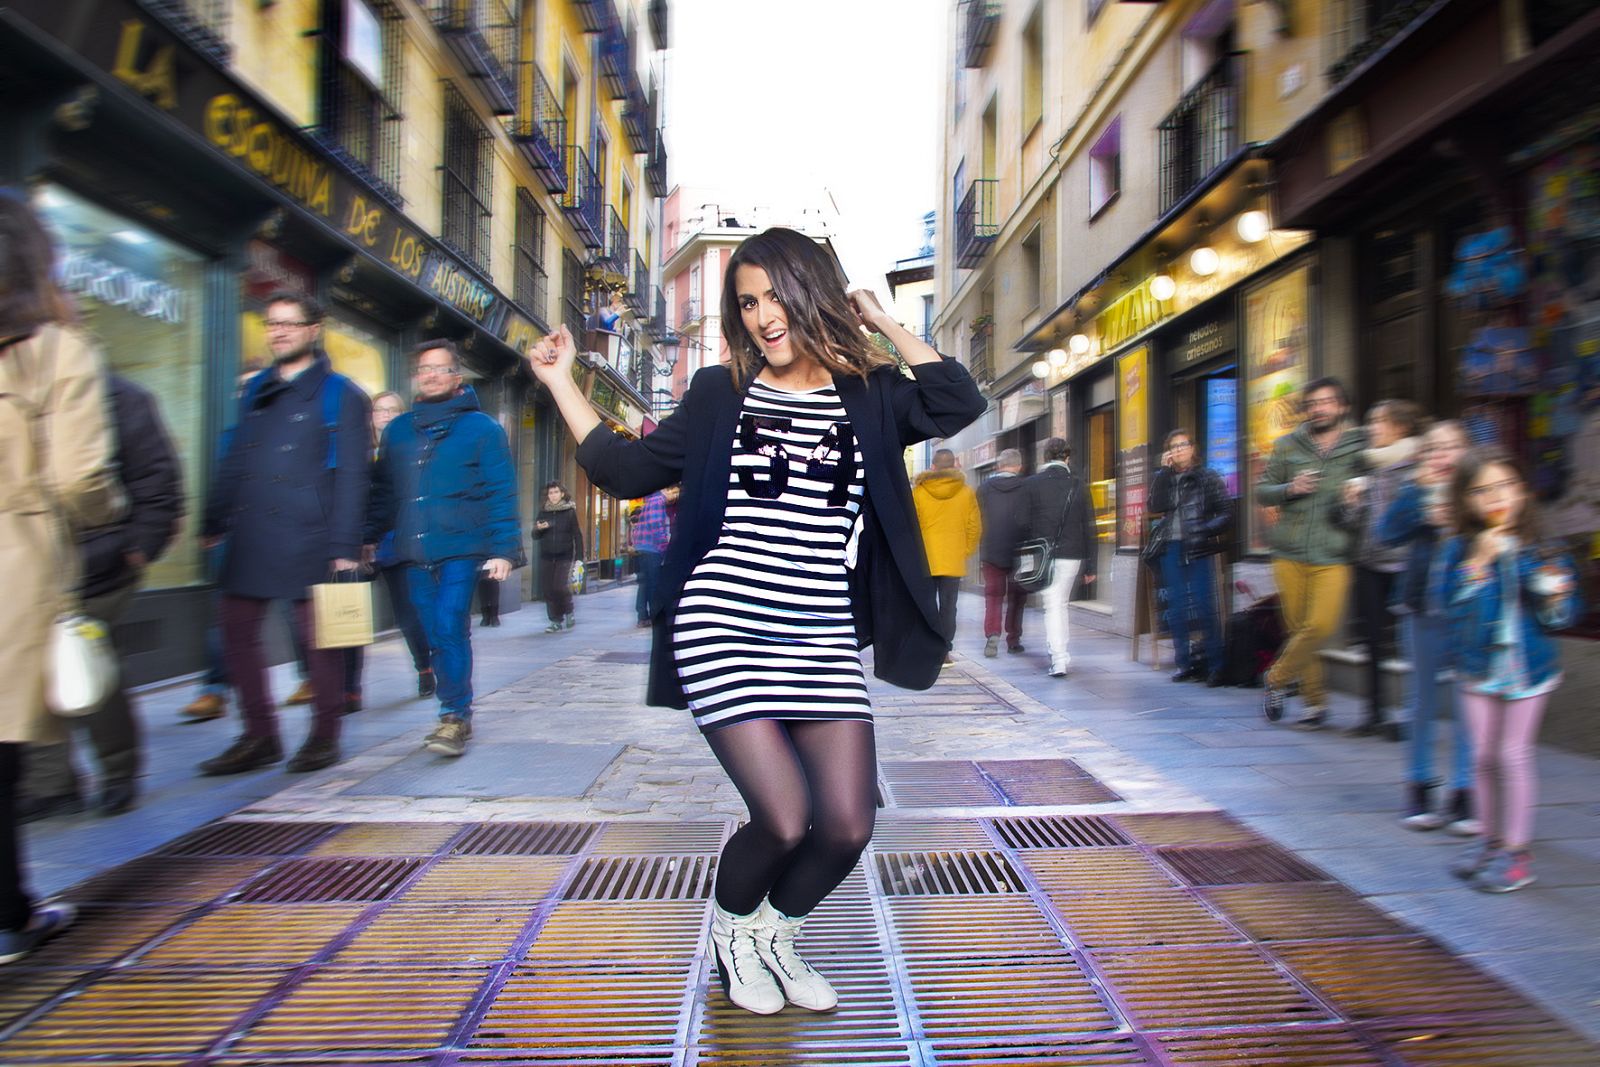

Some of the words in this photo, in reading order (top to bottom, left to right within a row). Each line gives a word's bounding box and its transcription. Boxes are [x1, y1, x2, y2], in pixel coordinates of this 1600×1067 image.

[112, 18, 177, 109] LA
[204, 94, 333, 216] ESQUINA
[347, 195, 382, 247] DE
[389, 228, 424, 277] LOS
[1189, 321, 1218, 345] helados
[1186, 336, 1223, 362] artesanos
